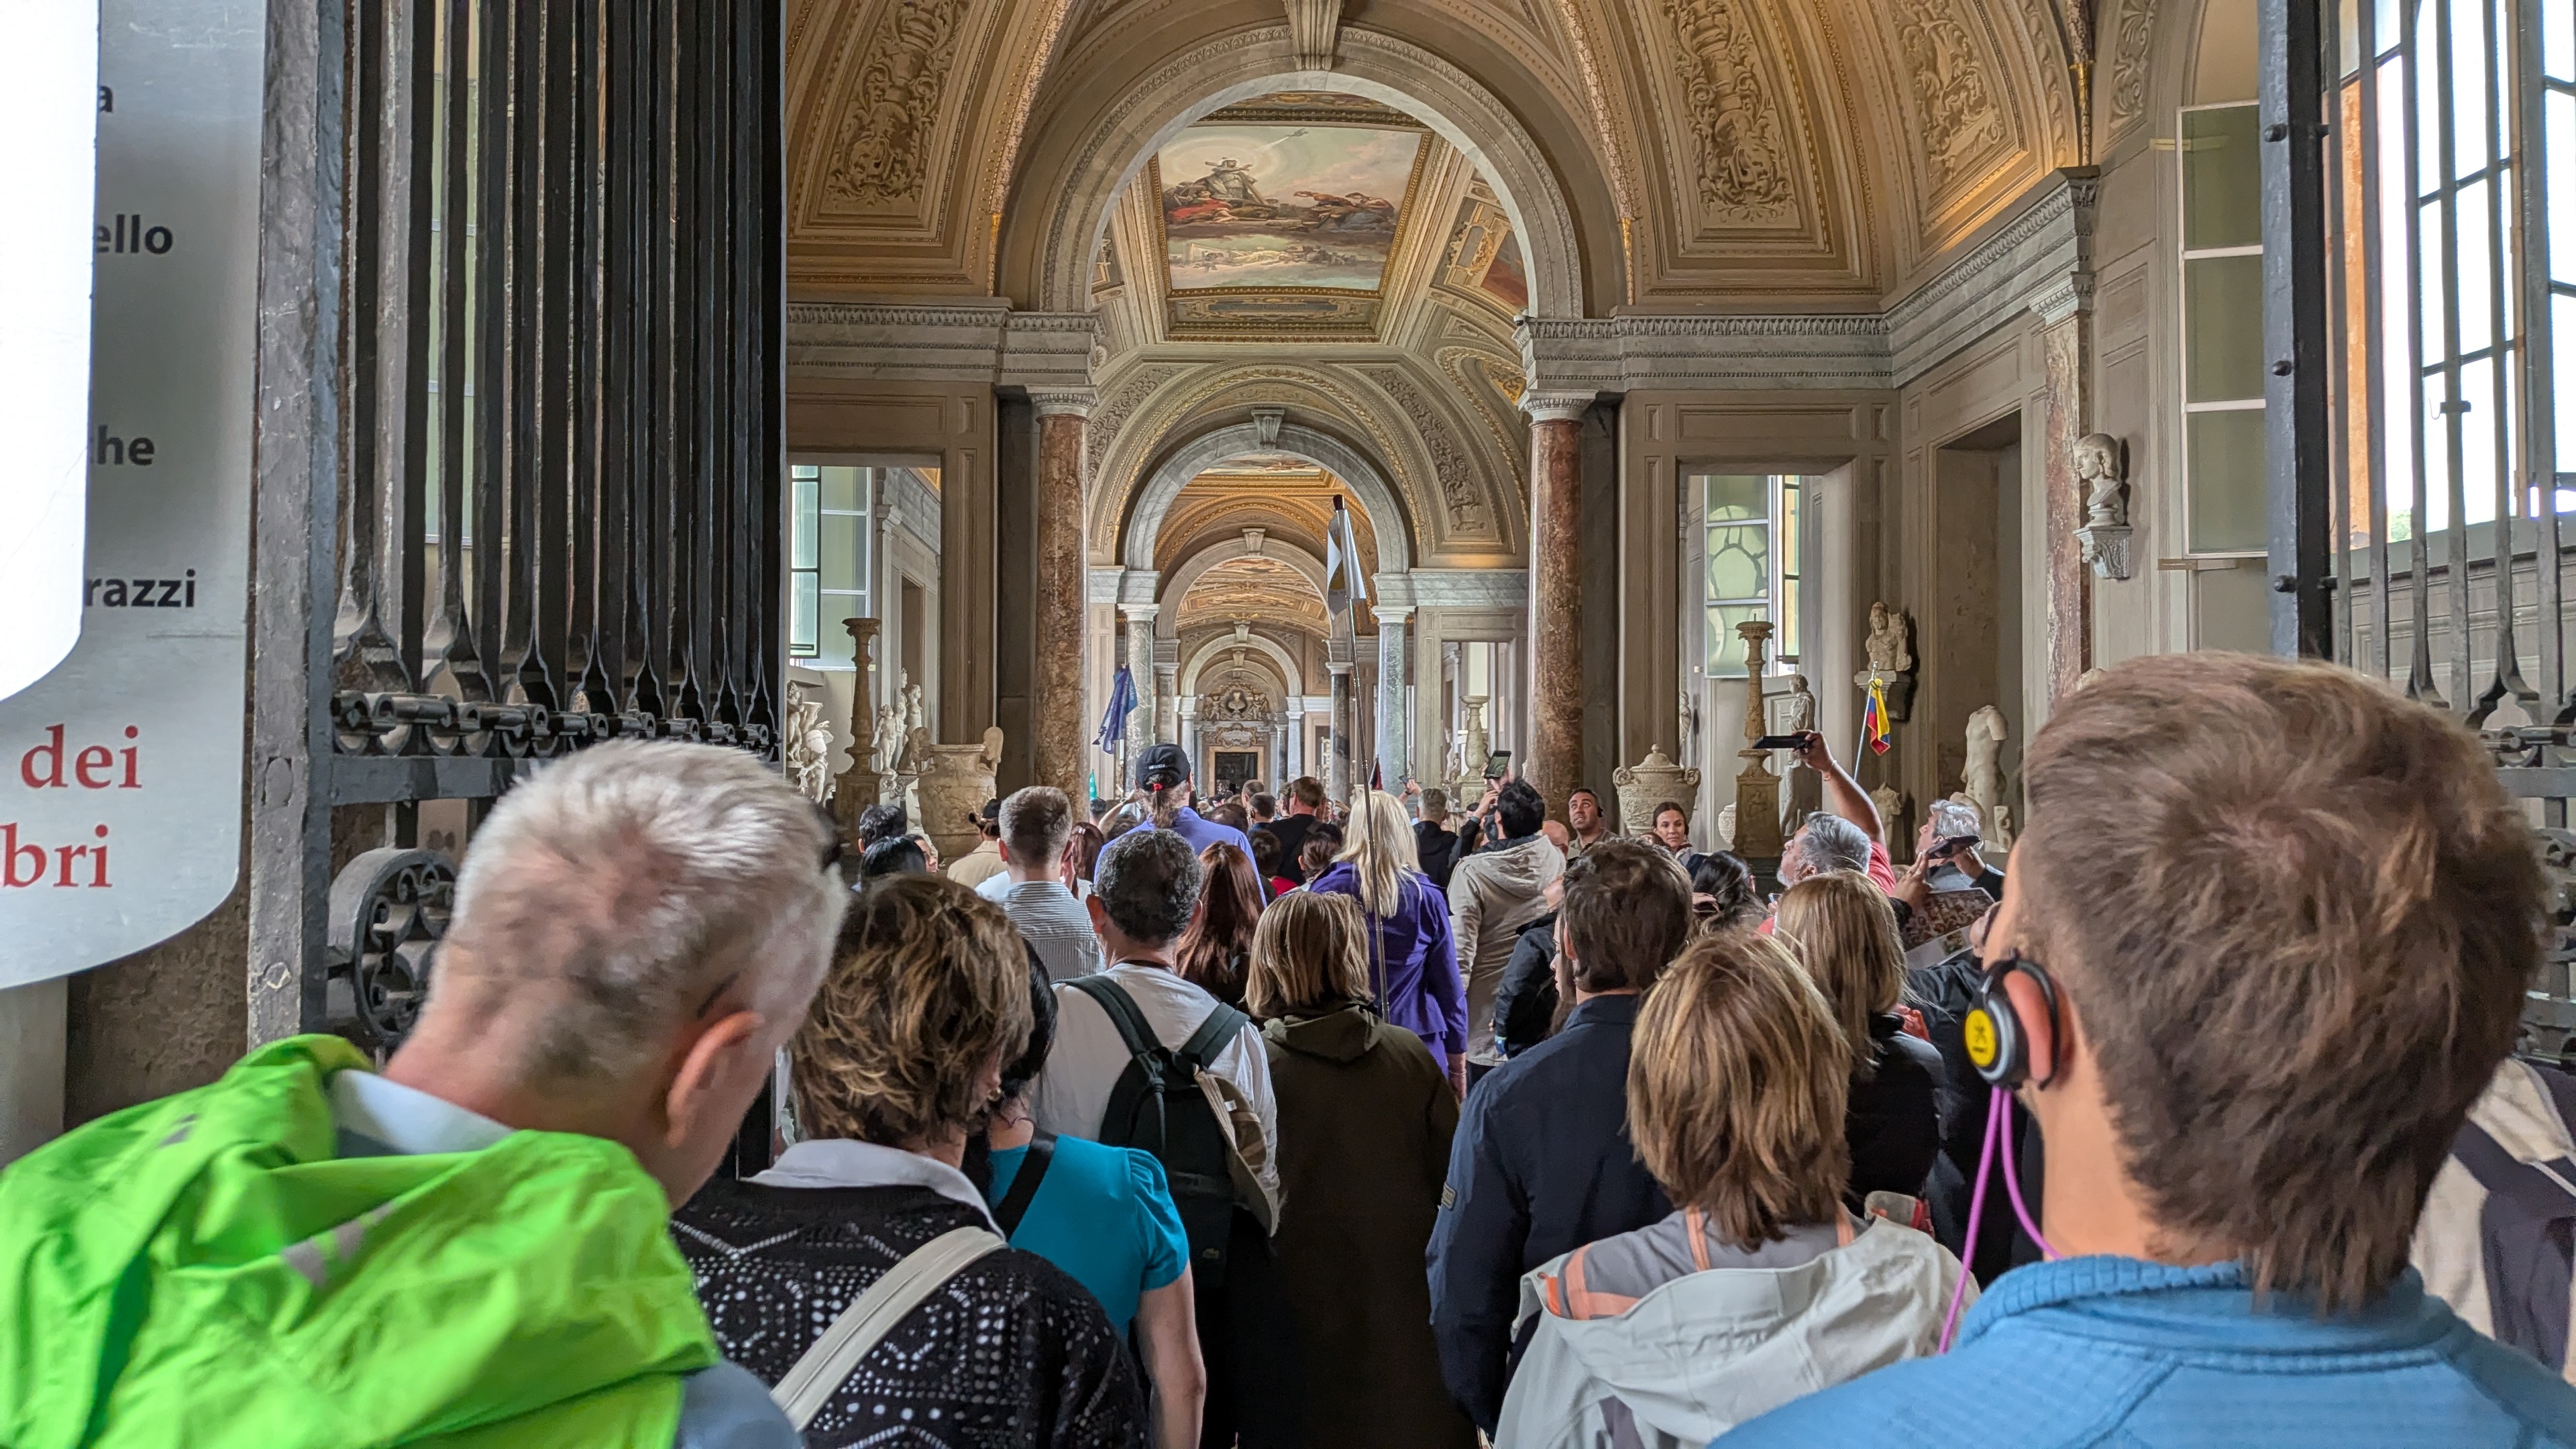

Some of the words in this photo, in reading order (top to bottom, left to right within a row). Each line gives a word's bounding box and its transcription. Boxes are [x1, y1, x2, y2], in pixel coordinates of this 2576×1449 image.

[96, 213, 173, 254] ello
[91, 425, 155, 466] he
[85, 568, 196, 607] razzi
[21, 723, 143, 790] dei
[0, 822, 113, 888] bri
